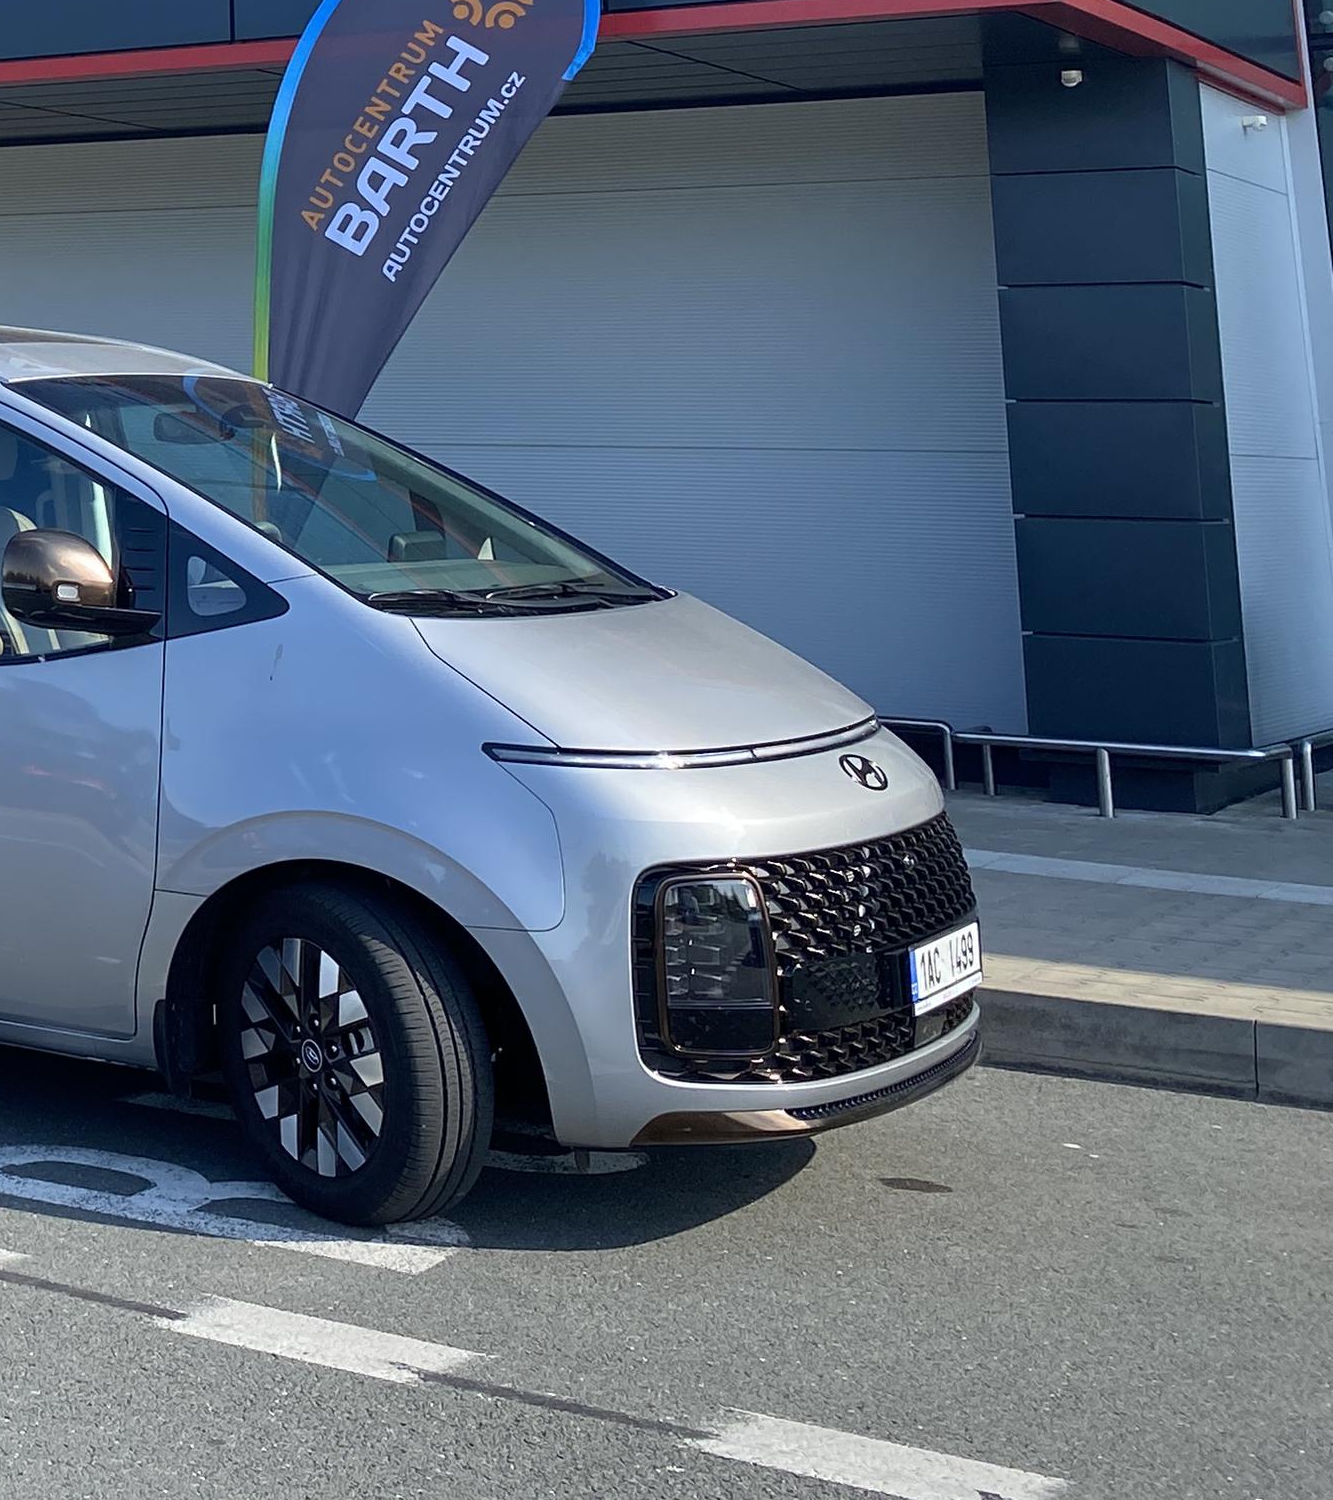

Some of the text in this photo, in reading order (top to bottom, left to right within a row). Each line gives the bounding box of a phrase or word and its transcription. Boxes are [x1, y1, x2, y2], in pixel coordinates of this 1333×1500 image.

[300, 19, 444, 232] AUTOCENTRUM
[324, 35, 490, 257] BARTH
[381, 71, 526, 283] AUTOCENTRUM.cz
[920, 931, 975, 991] 1AC 1499
